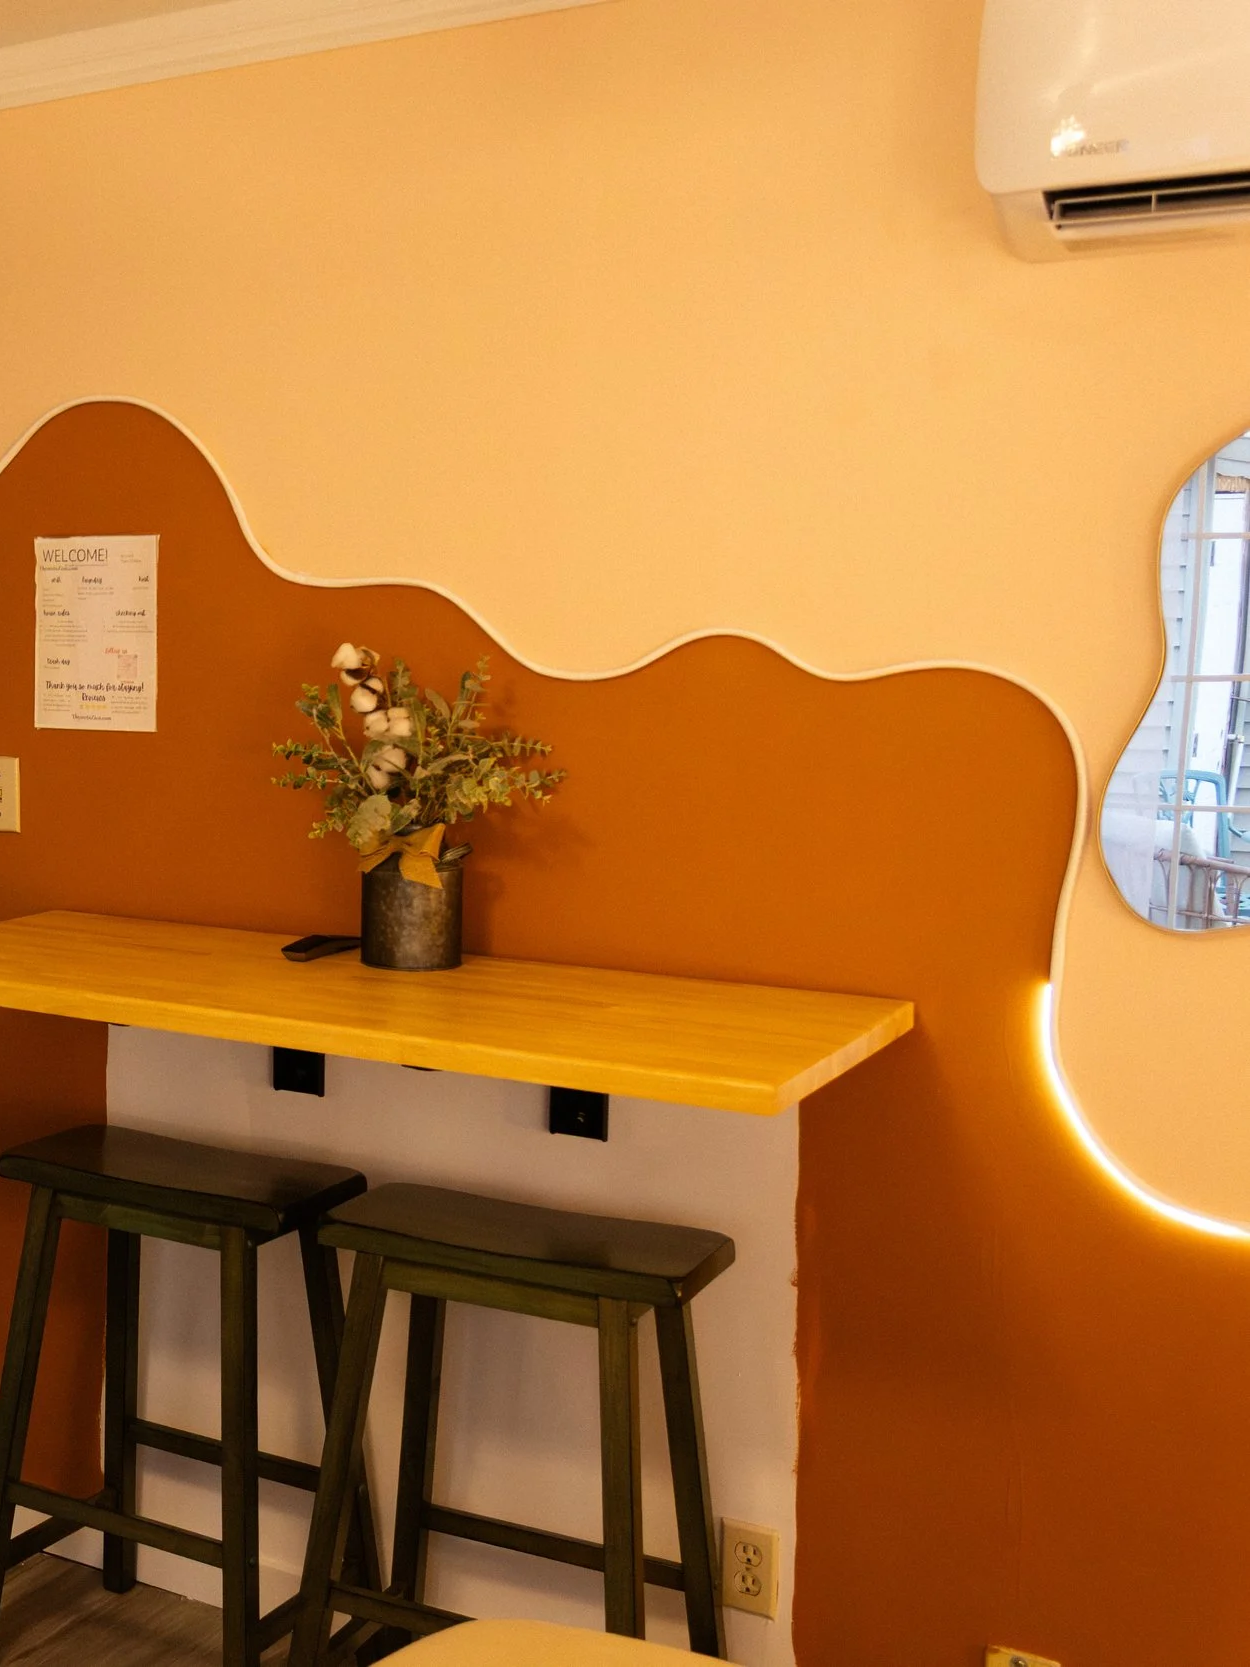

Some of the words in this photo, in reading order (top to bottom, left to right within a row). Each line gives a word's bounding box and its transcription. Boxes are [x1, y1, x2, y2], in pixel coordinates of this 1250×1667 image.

[42, 548, 108, 563] WELCOME!
[46, 680, 64, 690] Thank
[66, 683, 78, 691] you
[86, 682, 105, 691] much
[105, 682, 117, 691] for
